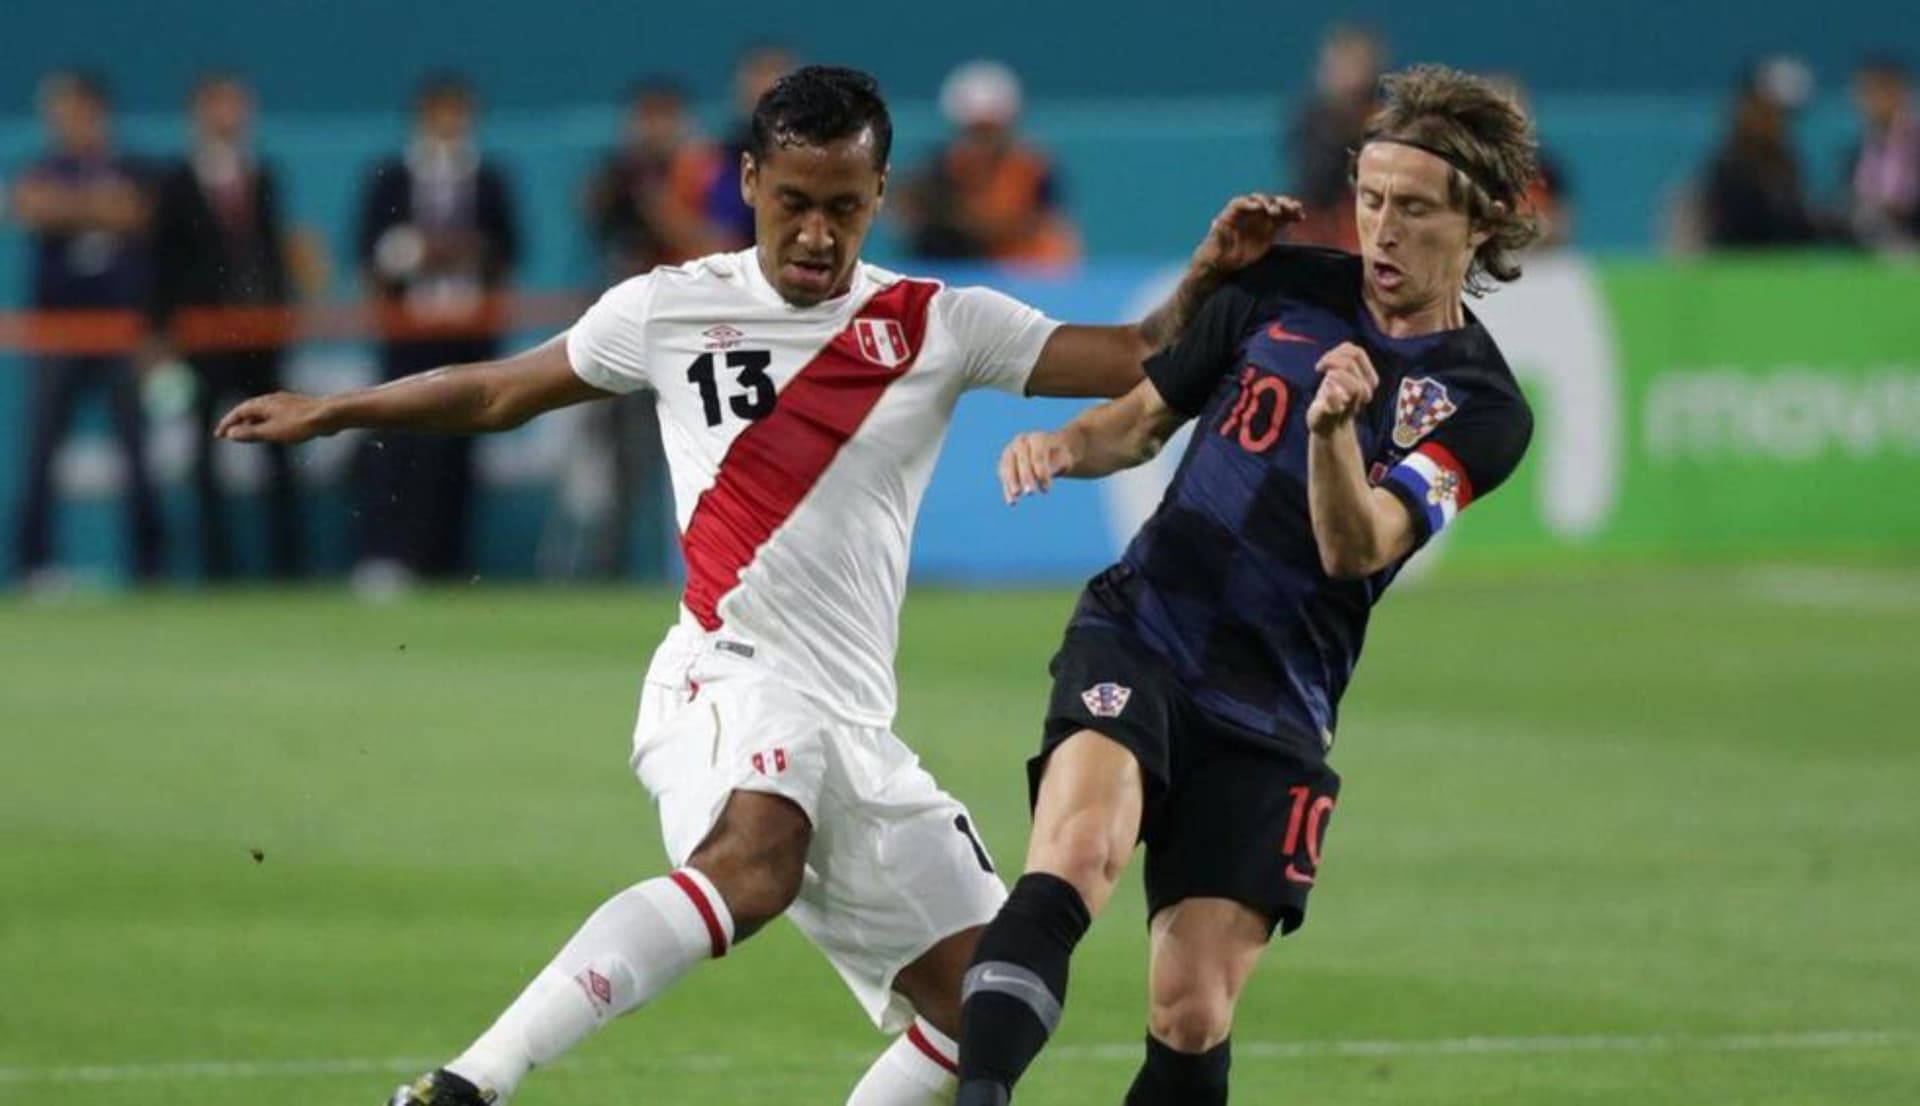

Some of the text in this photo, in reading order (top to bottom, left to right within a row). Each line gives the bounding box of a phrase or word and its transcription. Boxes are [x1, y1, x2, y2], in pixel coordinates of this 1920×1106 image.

[687, 350, 777, 427] 13
[1219, 363, 1289, 452] 10
[1282, 785, 1335, 866] 10
